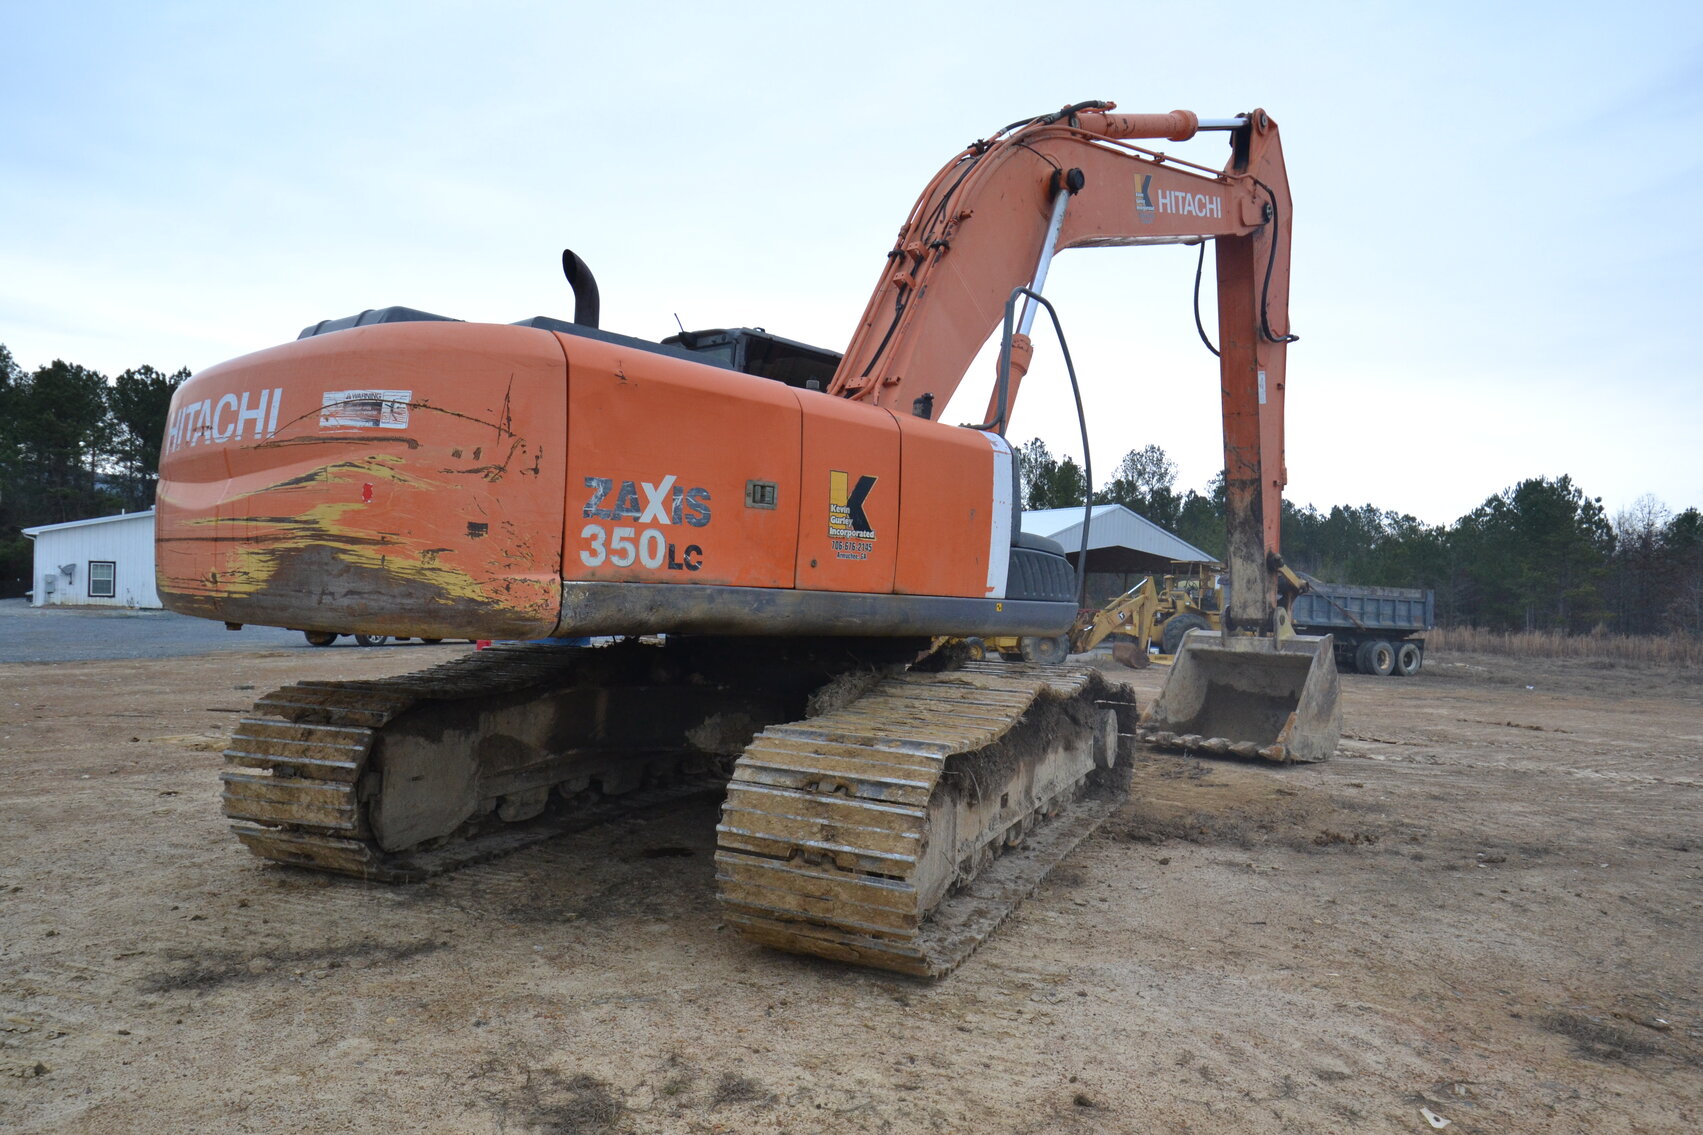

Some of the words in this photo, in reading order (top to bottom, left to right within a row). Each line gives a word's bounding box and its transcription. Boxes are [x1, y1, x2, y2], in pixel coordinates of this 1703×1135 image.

[1157, 189, 1222, 219] HITACHI
[165, 387, 283, 456] HITACHI
[582, 474, 712, 528] ZAXIS
[830, 504, 851, 514] Kevin
[830, 516, 853, 527] Gurley
[829, 527, 875, 539] Incorporated
